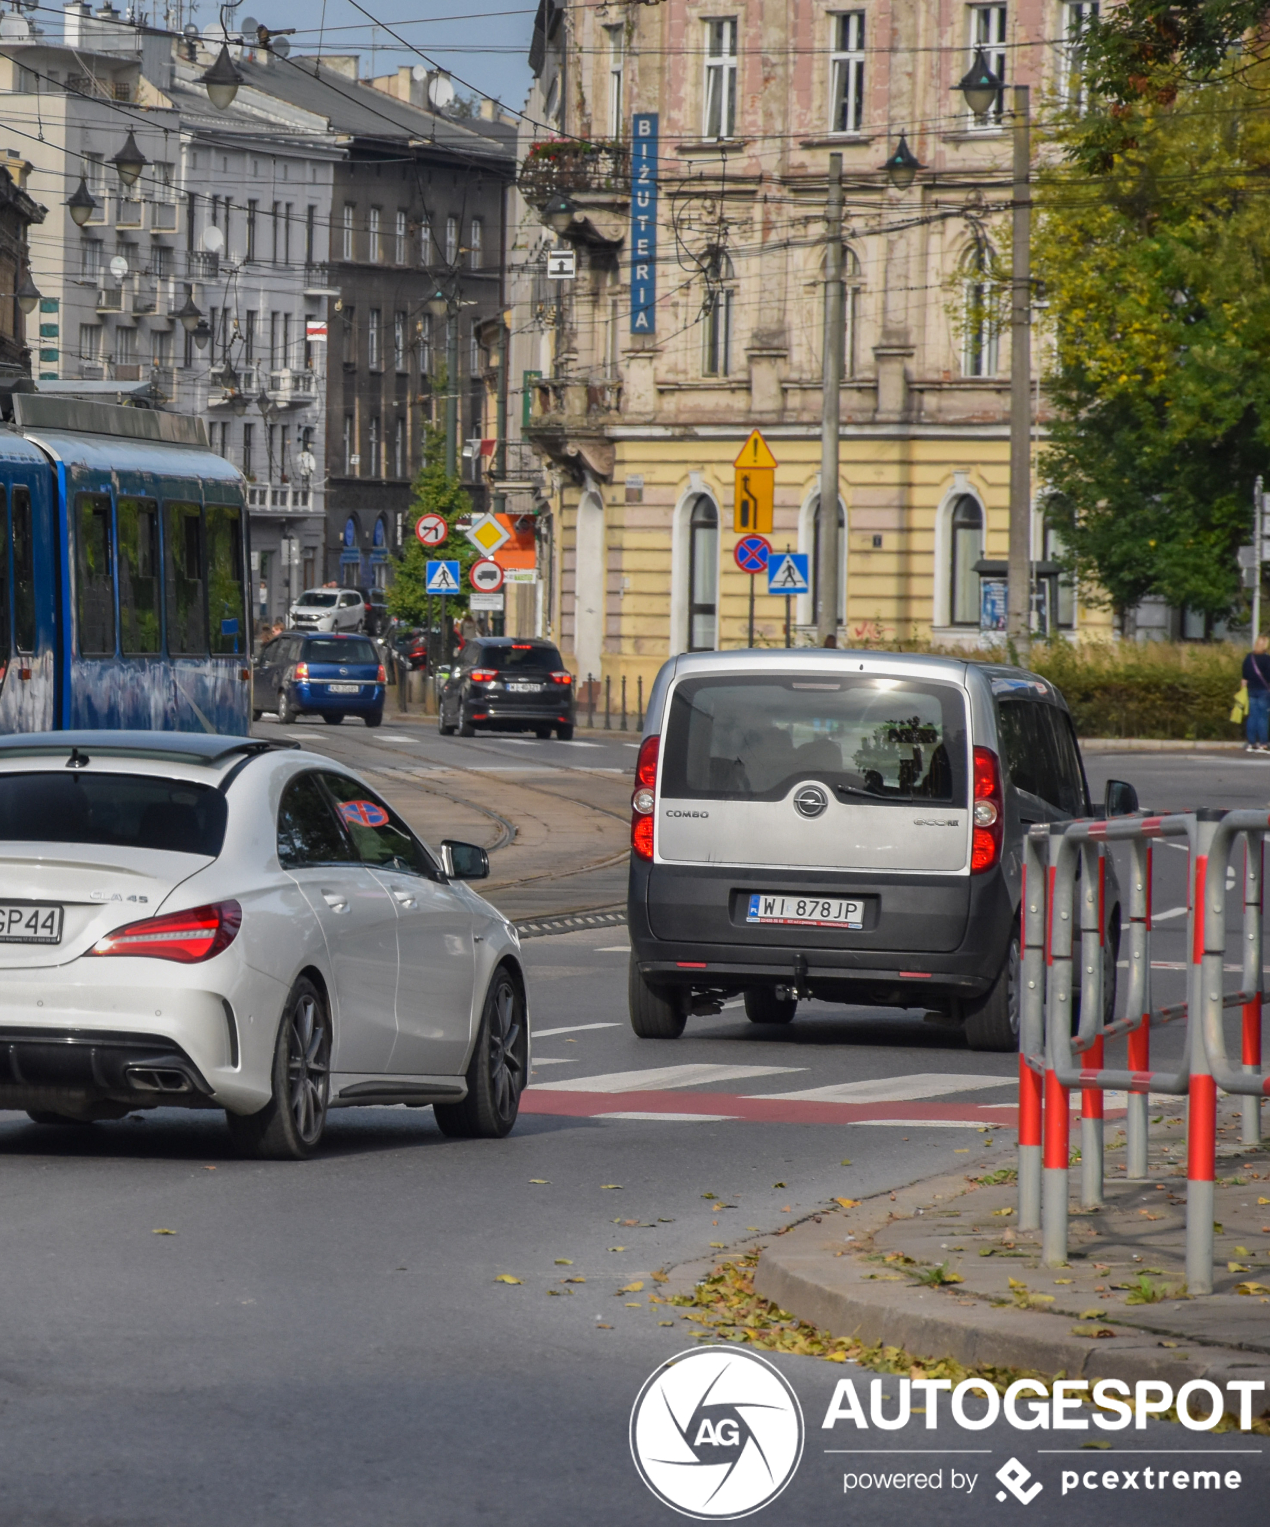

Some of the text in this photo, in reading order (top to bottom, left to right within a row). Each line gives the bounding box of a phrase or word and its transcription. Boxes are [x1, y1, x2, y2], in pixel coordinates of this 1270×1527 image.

[635, 120, 651, 328] BIŻUTERIA
[665, 810, 710, 819] COMBO
[126, 895, 148, 904] 45
[763, 898, 858, 920] WI 878JP
